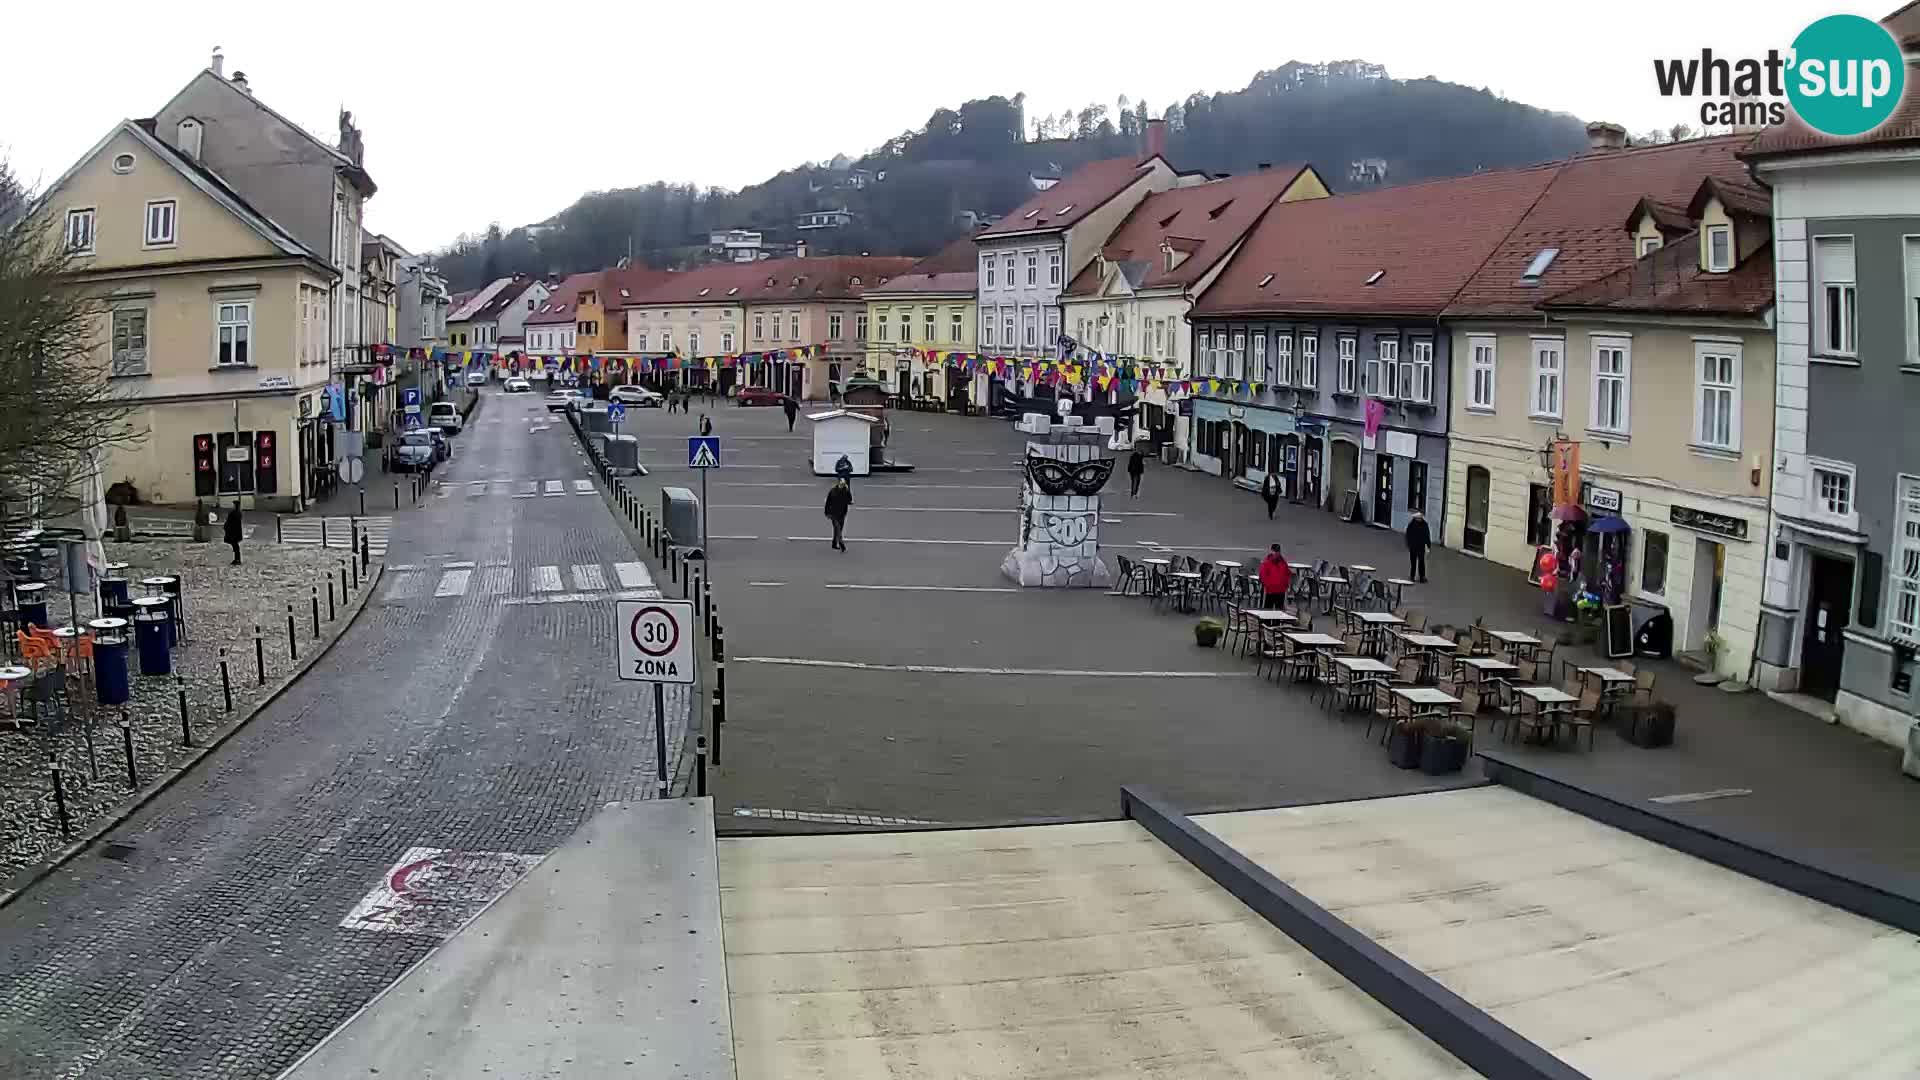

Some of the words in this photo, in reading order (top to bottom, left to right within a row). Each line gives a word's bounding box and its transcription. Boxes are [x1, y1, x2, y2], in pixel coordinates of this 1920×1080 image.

[1048, 516, 1087, 545] 200
[643, 622, 668, 643] 30
[634, 659, 678, 676] ZONA
